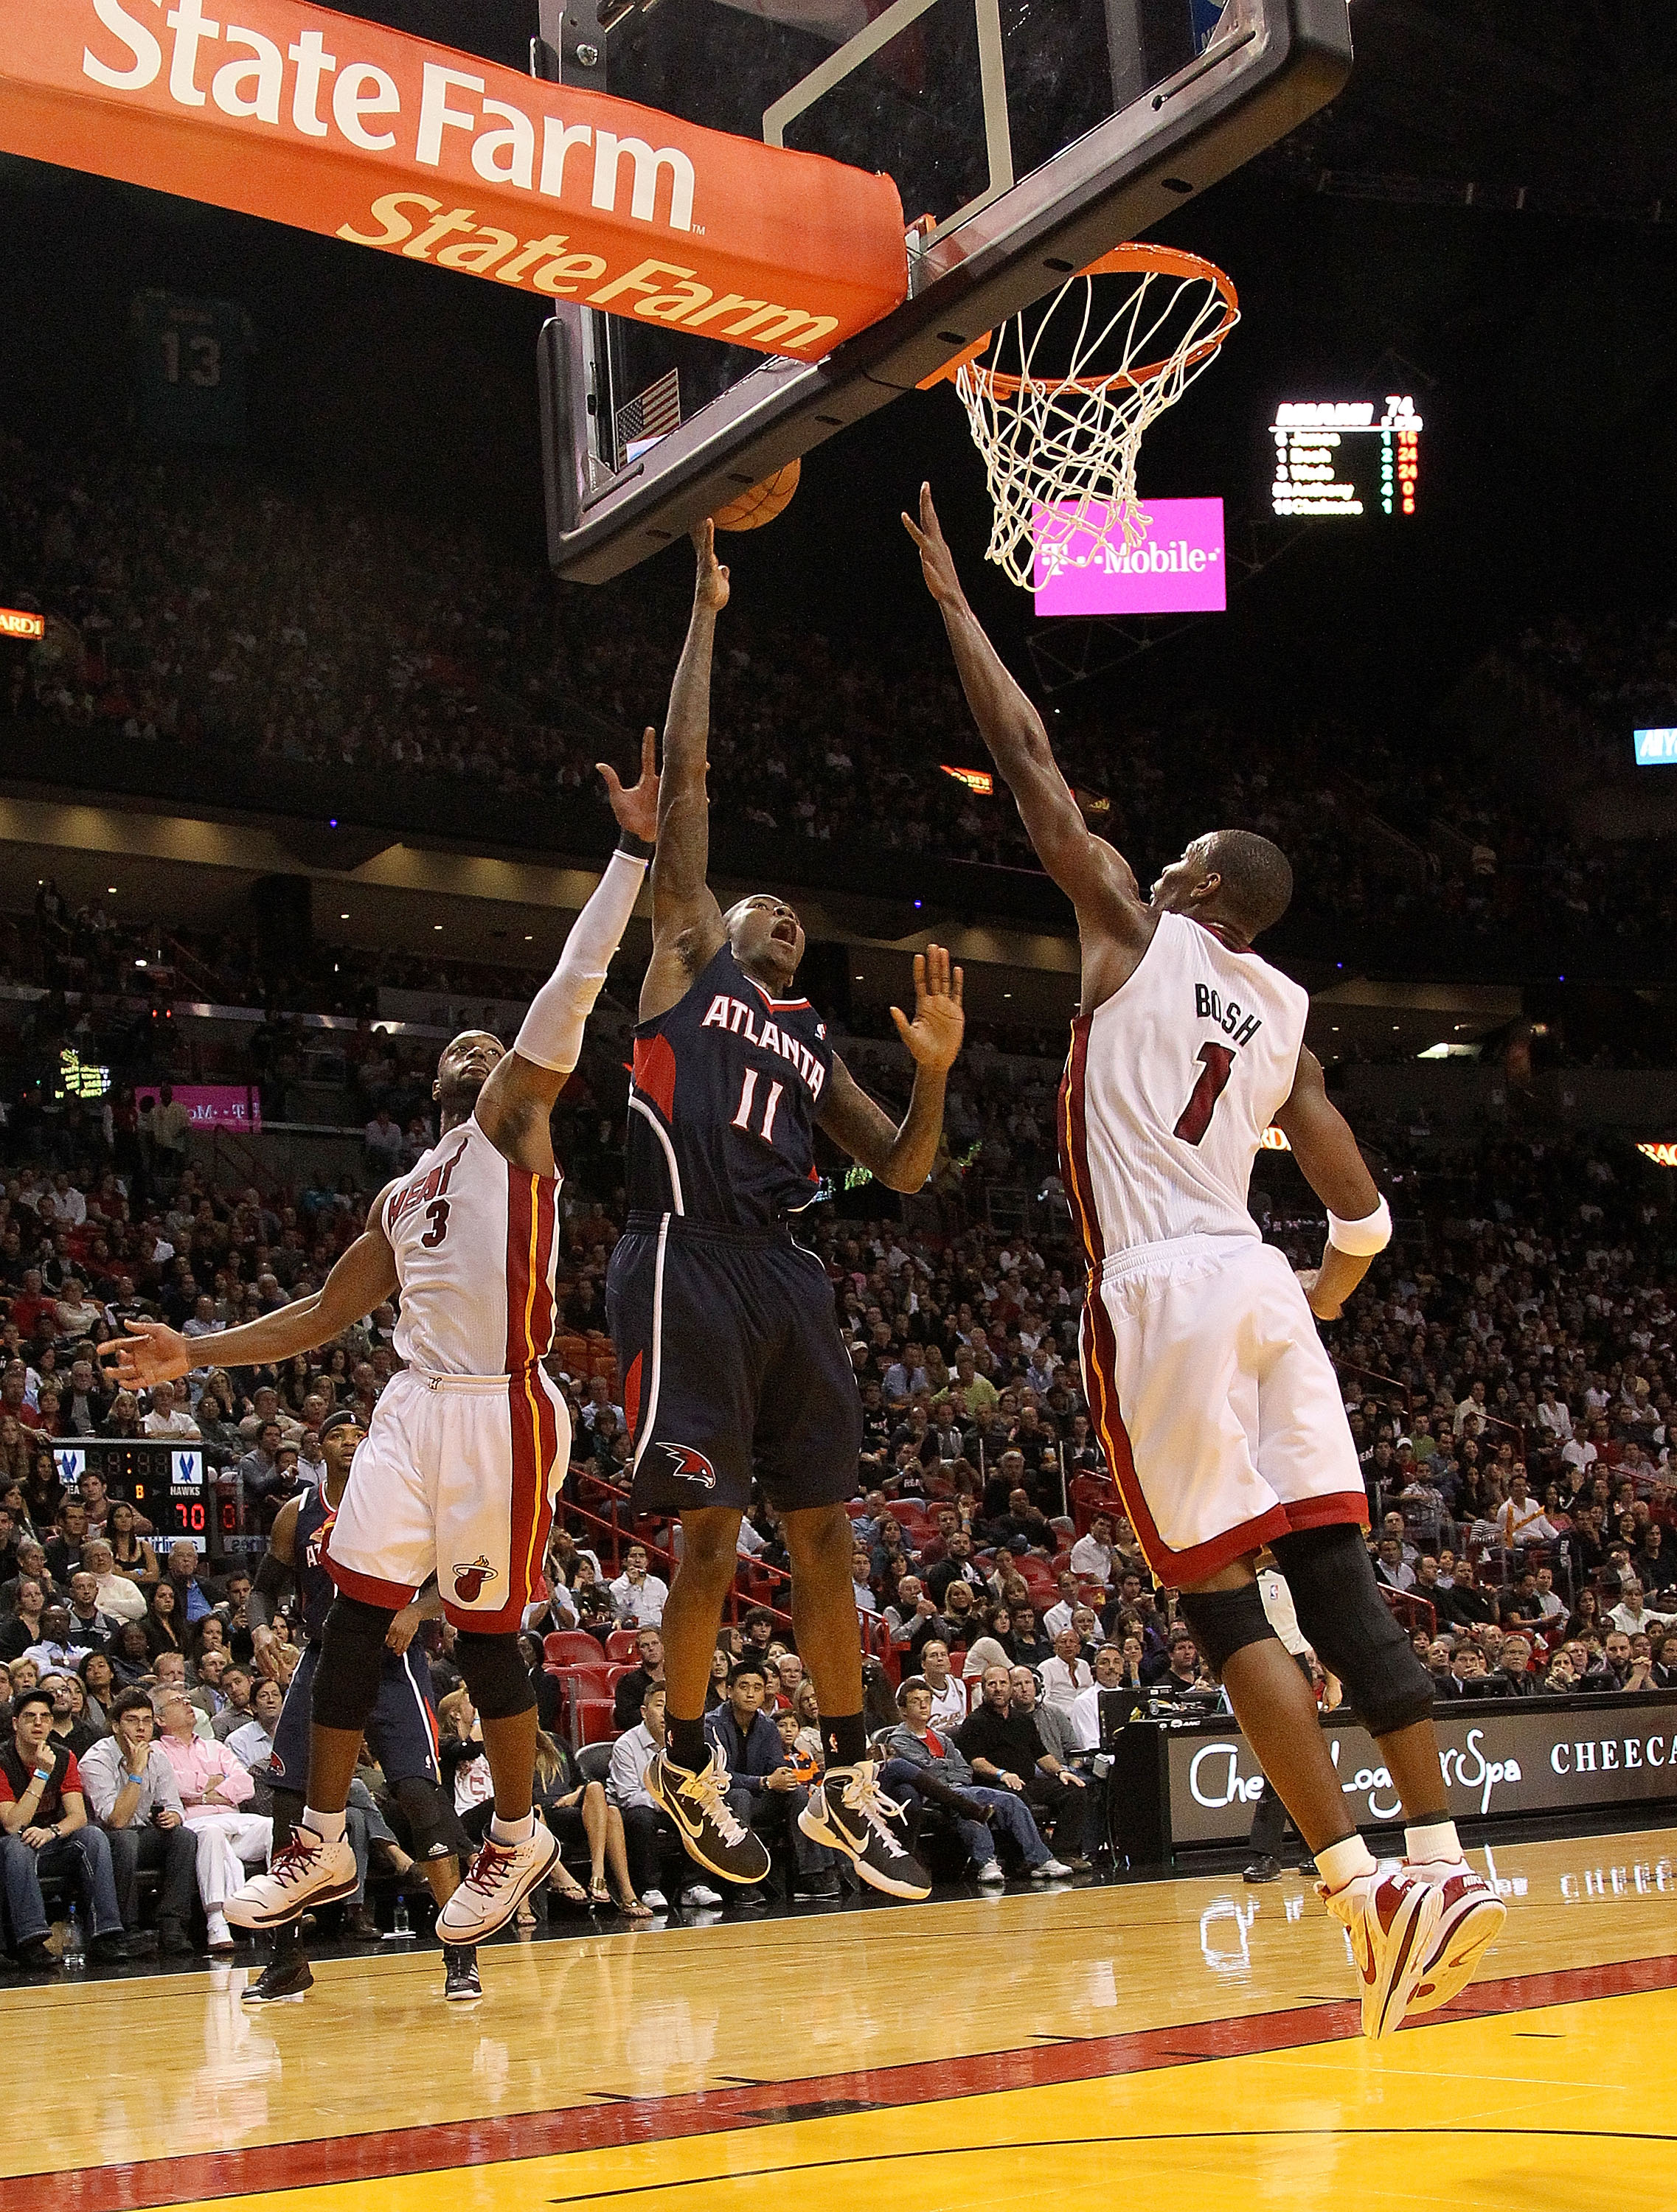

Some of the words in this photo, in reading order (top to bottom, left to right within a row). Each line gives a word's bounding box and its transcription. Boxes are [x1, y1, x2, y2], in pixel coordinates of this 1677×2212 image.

[83, 0, 401, 150] State
[415, 60, 695, 232] Farm
[336, 192, 607, 293] State
[587, 258, 840, 349] Farm
[1385, 395, 1415, 418] 74
[1381, 430, 1392, 446] 1
[1398, 430, 1418, 445] 16
[1381, 447, 1393, 463] 2
[1398, 446, 1418, 463] 24
[1380, 481, 1394, 497] 4
[1402, 481, 1414, 497] 0
[1381, 464, 1393, 481] 2
[1398, 463, 1418, 480] 24
[1381, 498, 1392, 515] 1
[1403, 497, 1415, 515] 5
[1195, 983, 1262, 1047] BOSH
[701, 993, 826, 1104] ATLANTA
[730, 1067, 784, 1144] 11
[1173, 1041, 1237, 1147] 1
[388, 1137, 469, 1237] HEAT
[421, 1197, 451, 1248] 3
[170, 1485, 201, 1497] HAWKS
[176, 1503, 206, 1531] 70
